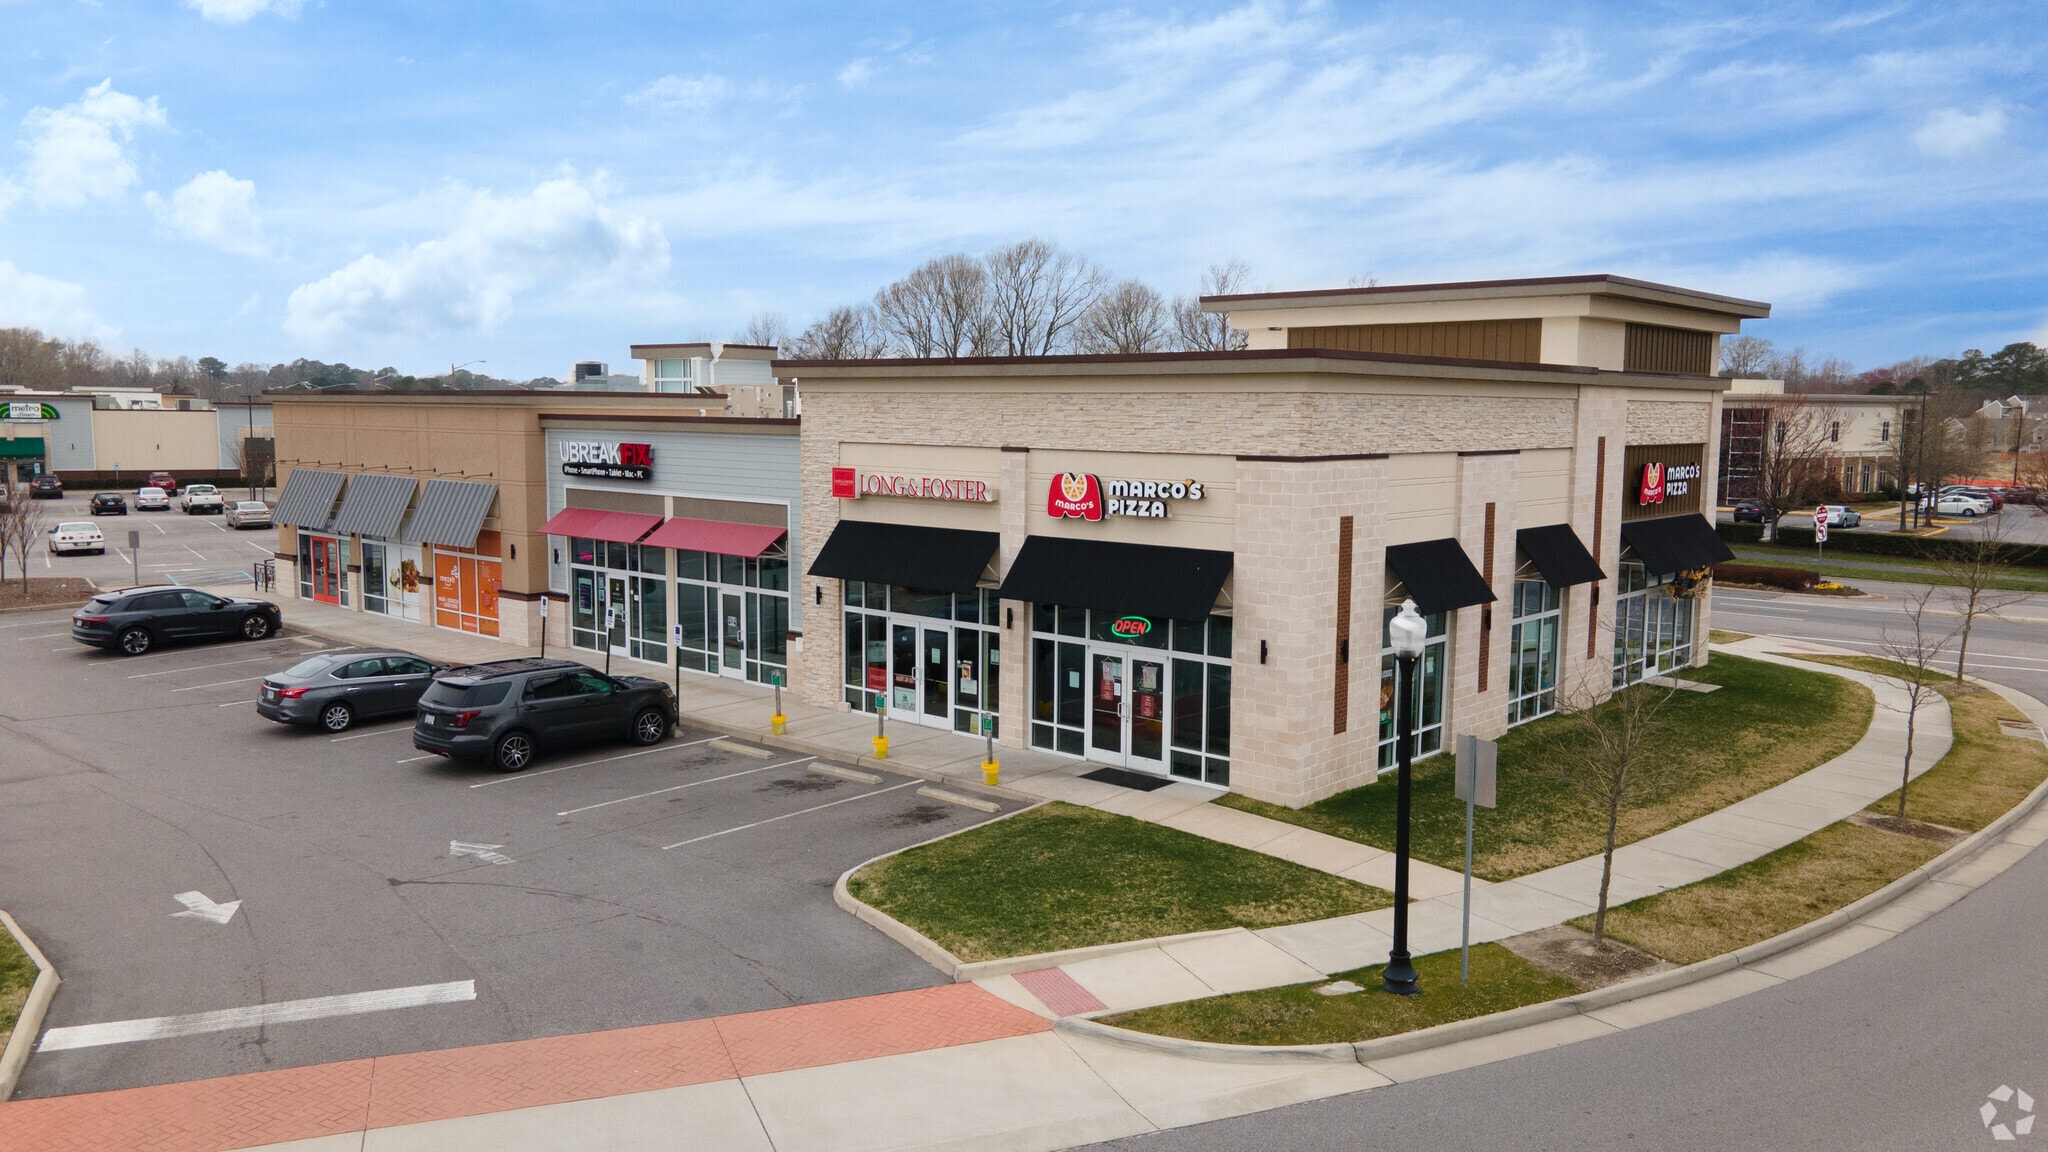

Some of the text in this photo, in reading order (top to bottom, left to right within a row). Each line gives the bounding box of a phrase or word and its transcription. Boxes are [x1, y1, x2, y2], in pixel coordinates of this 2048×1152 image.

[11, 404, 40, 412] metro
[1667, 463, 1700, 481] MARCO'S
[1108, 479, 1203, 500] MARCO'S
[1666, 481, 1688, 496] PIZZA
[1055, 499, 1094, 511] MARCO'S
[1108, 499, 1165, 518] PIZZA
[1114, 619, 1147, 635] OPEN
